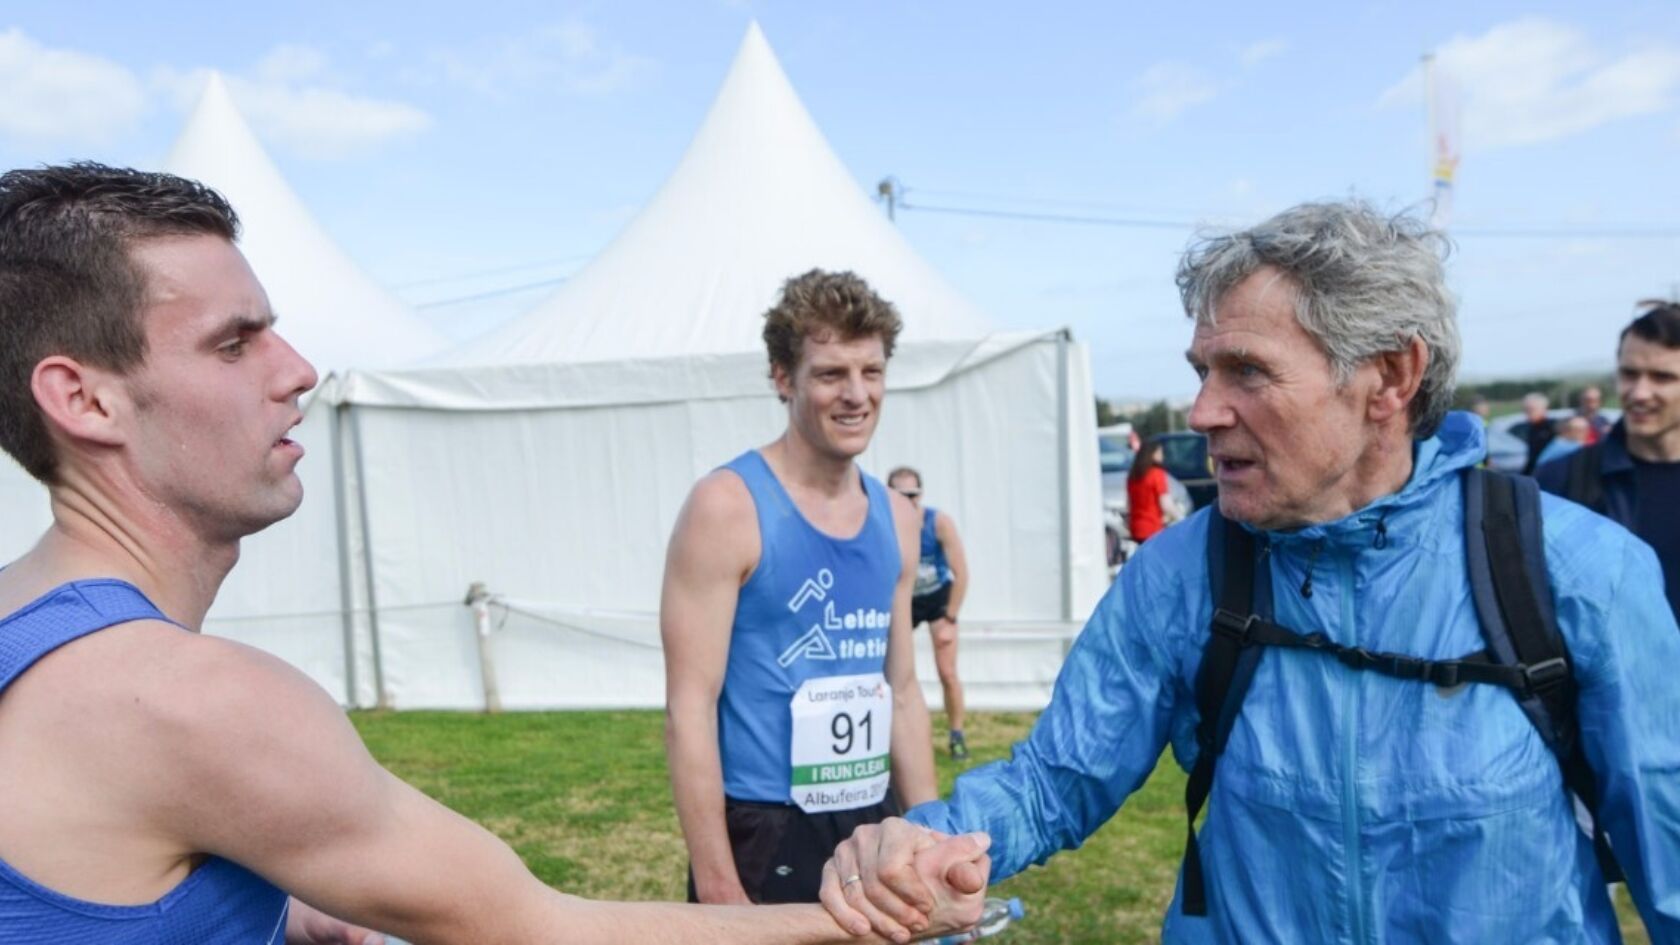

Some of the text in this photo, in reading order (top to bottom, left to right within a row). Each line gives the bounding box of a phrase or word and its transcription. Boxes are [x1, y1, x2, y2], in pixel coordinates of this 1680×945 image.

[831, 710, 872, 755] 91
[811, 767, 818, 782] I
[820, 763, 852, 781] RUN
[804, 788, 868, 806] Albufeira
